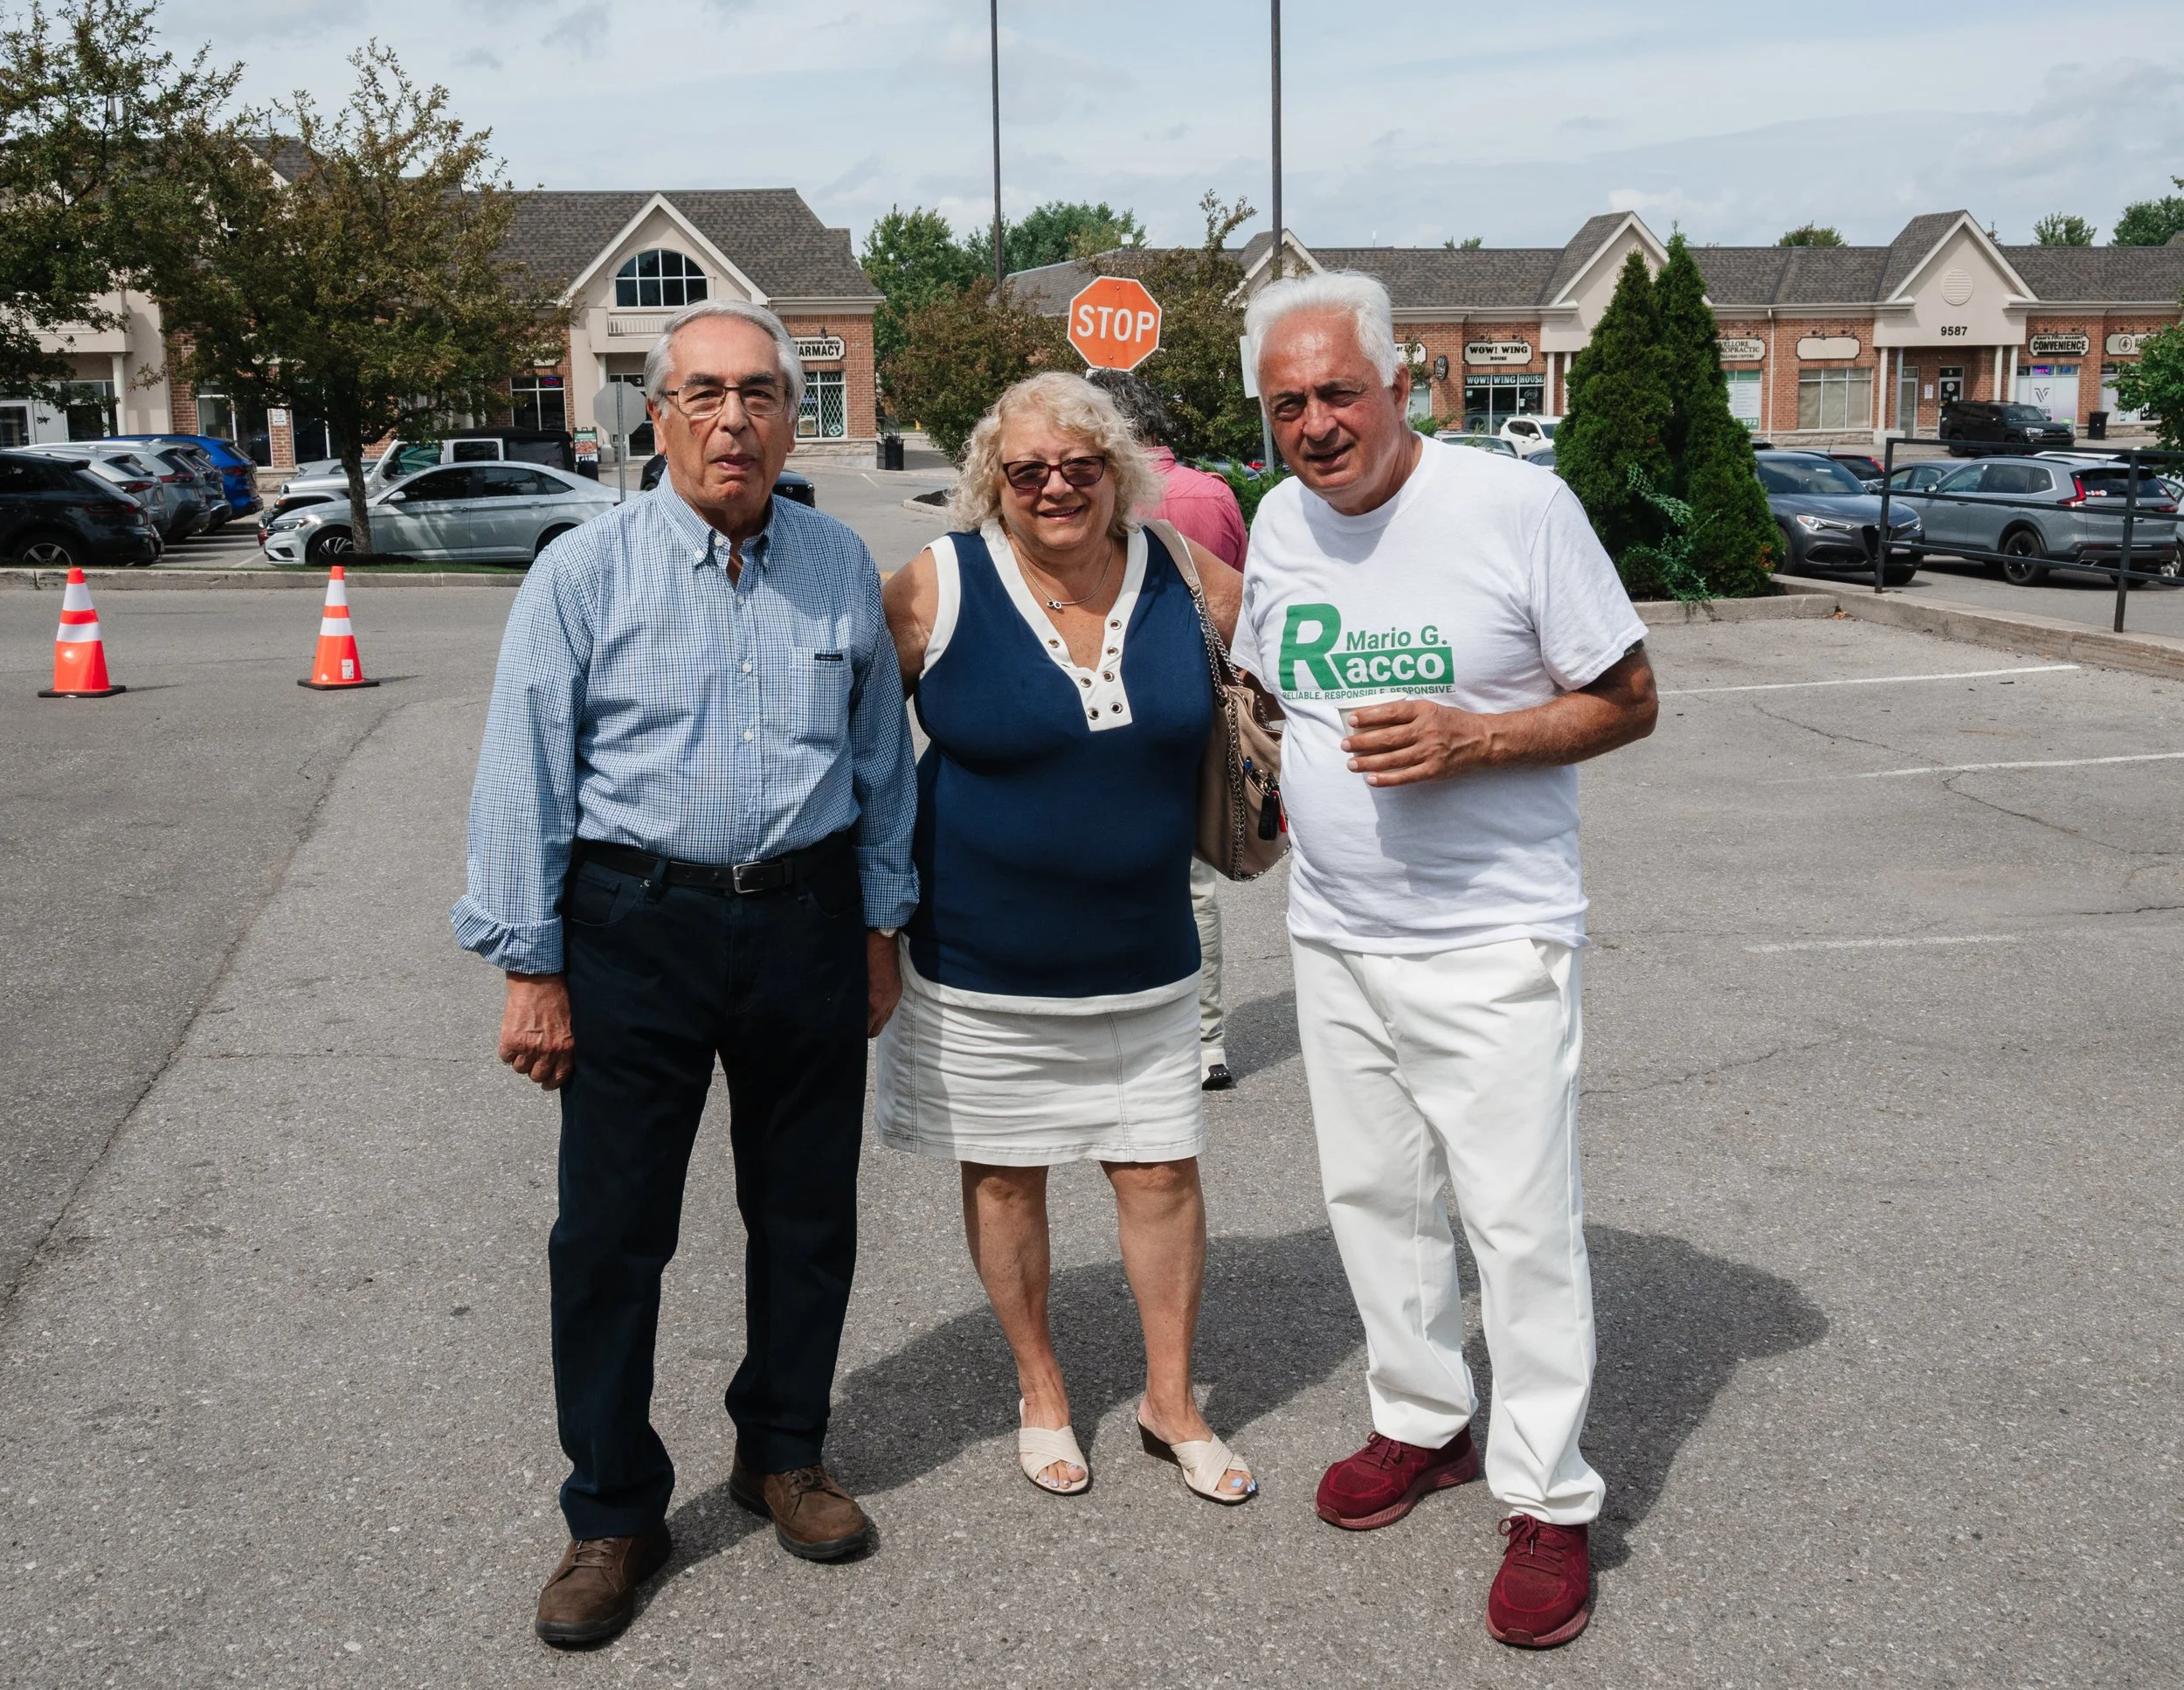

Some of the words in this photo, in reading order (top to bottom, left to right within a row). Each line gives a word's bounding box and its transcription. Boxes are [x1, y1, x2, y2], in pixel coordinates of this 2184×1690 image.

[1076, 304, 1155, 343] STOP
[1940, 326, 1967, 336] 9587
[2033, 341, 2086, 350] CONVENIENCE
[796, 345, 840, 357] ARMACY
[1466, 376, 1489, 384] WOW!
[1519, 375, 1544, 384] HOUSE
[1346, 627, 1412, 651] Mario
[1420, 625, 1448, 646] G.
[1282, 691, 1323, 700] RELIABLE.
